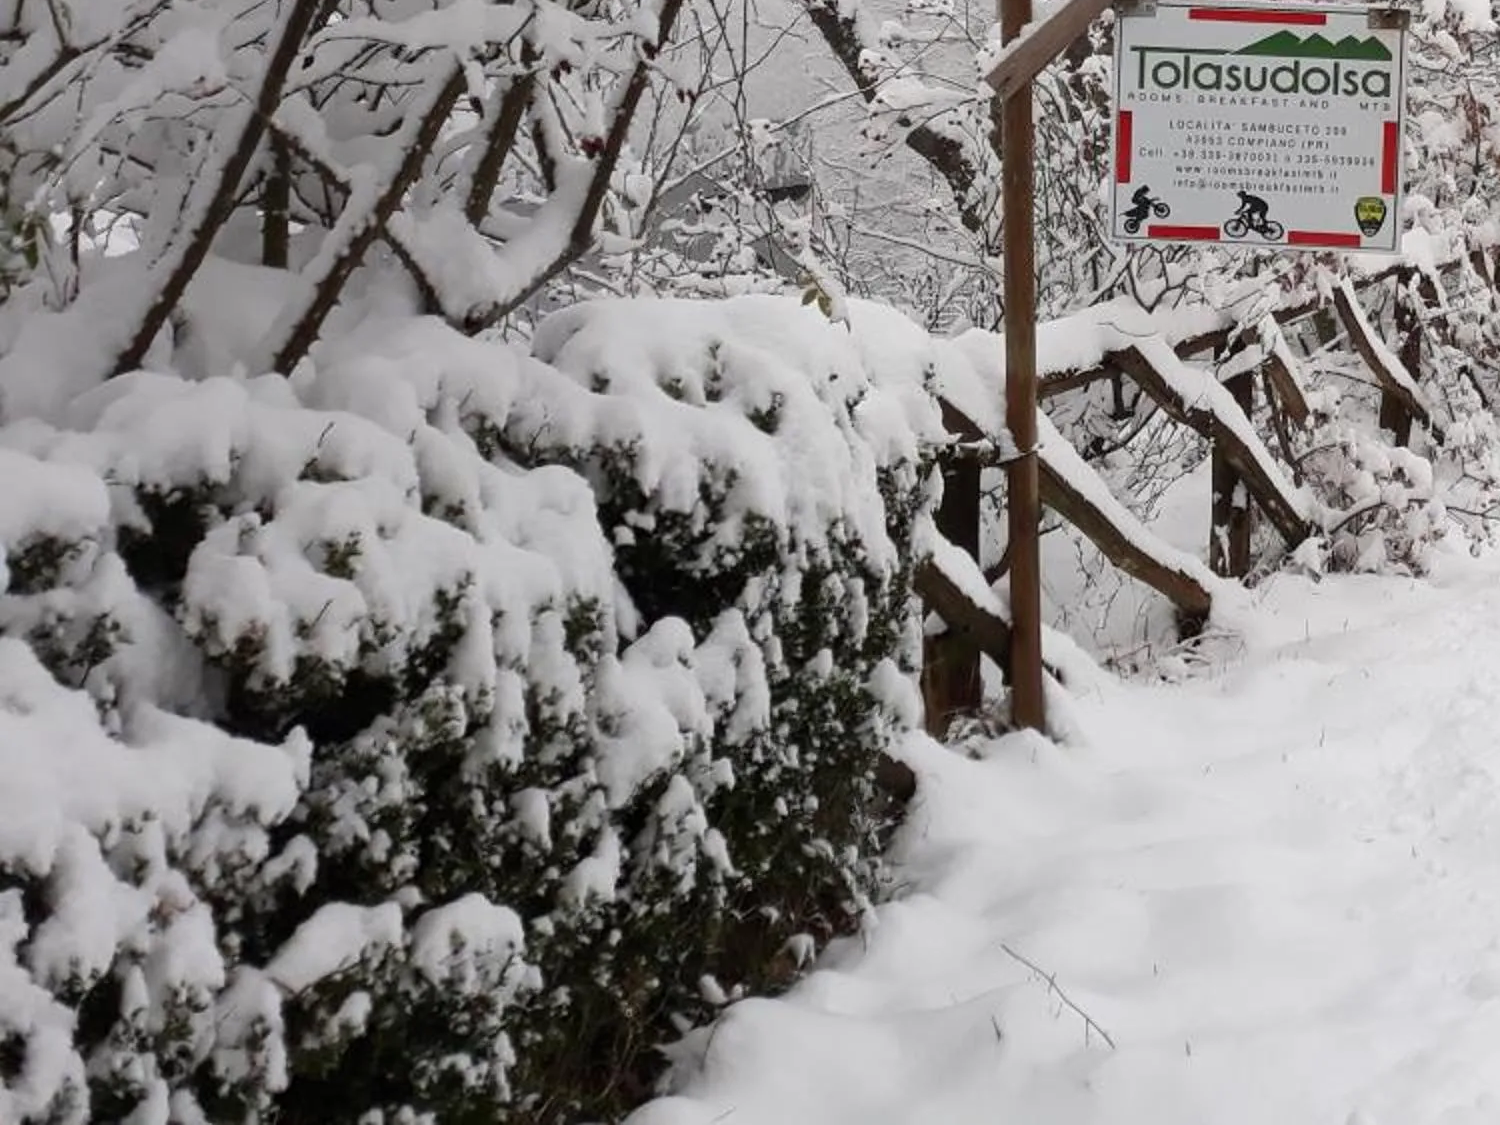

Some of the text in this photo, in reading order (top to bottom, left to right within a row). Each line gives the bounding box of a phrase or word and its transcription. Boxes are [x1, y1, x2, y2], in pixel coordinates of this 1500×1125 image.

[1130, 45, 1392, 97] Tolasudolsa
[1197, 94, 1289, 107] BREAKFAST
[1299, 99, 1330, 110] AND
[1241, 122, 1321, 136] SAMBUCETO
[1227, 136, 1297, 149] COMPIANO
[1301, 139, 1330, 150] (PR)
